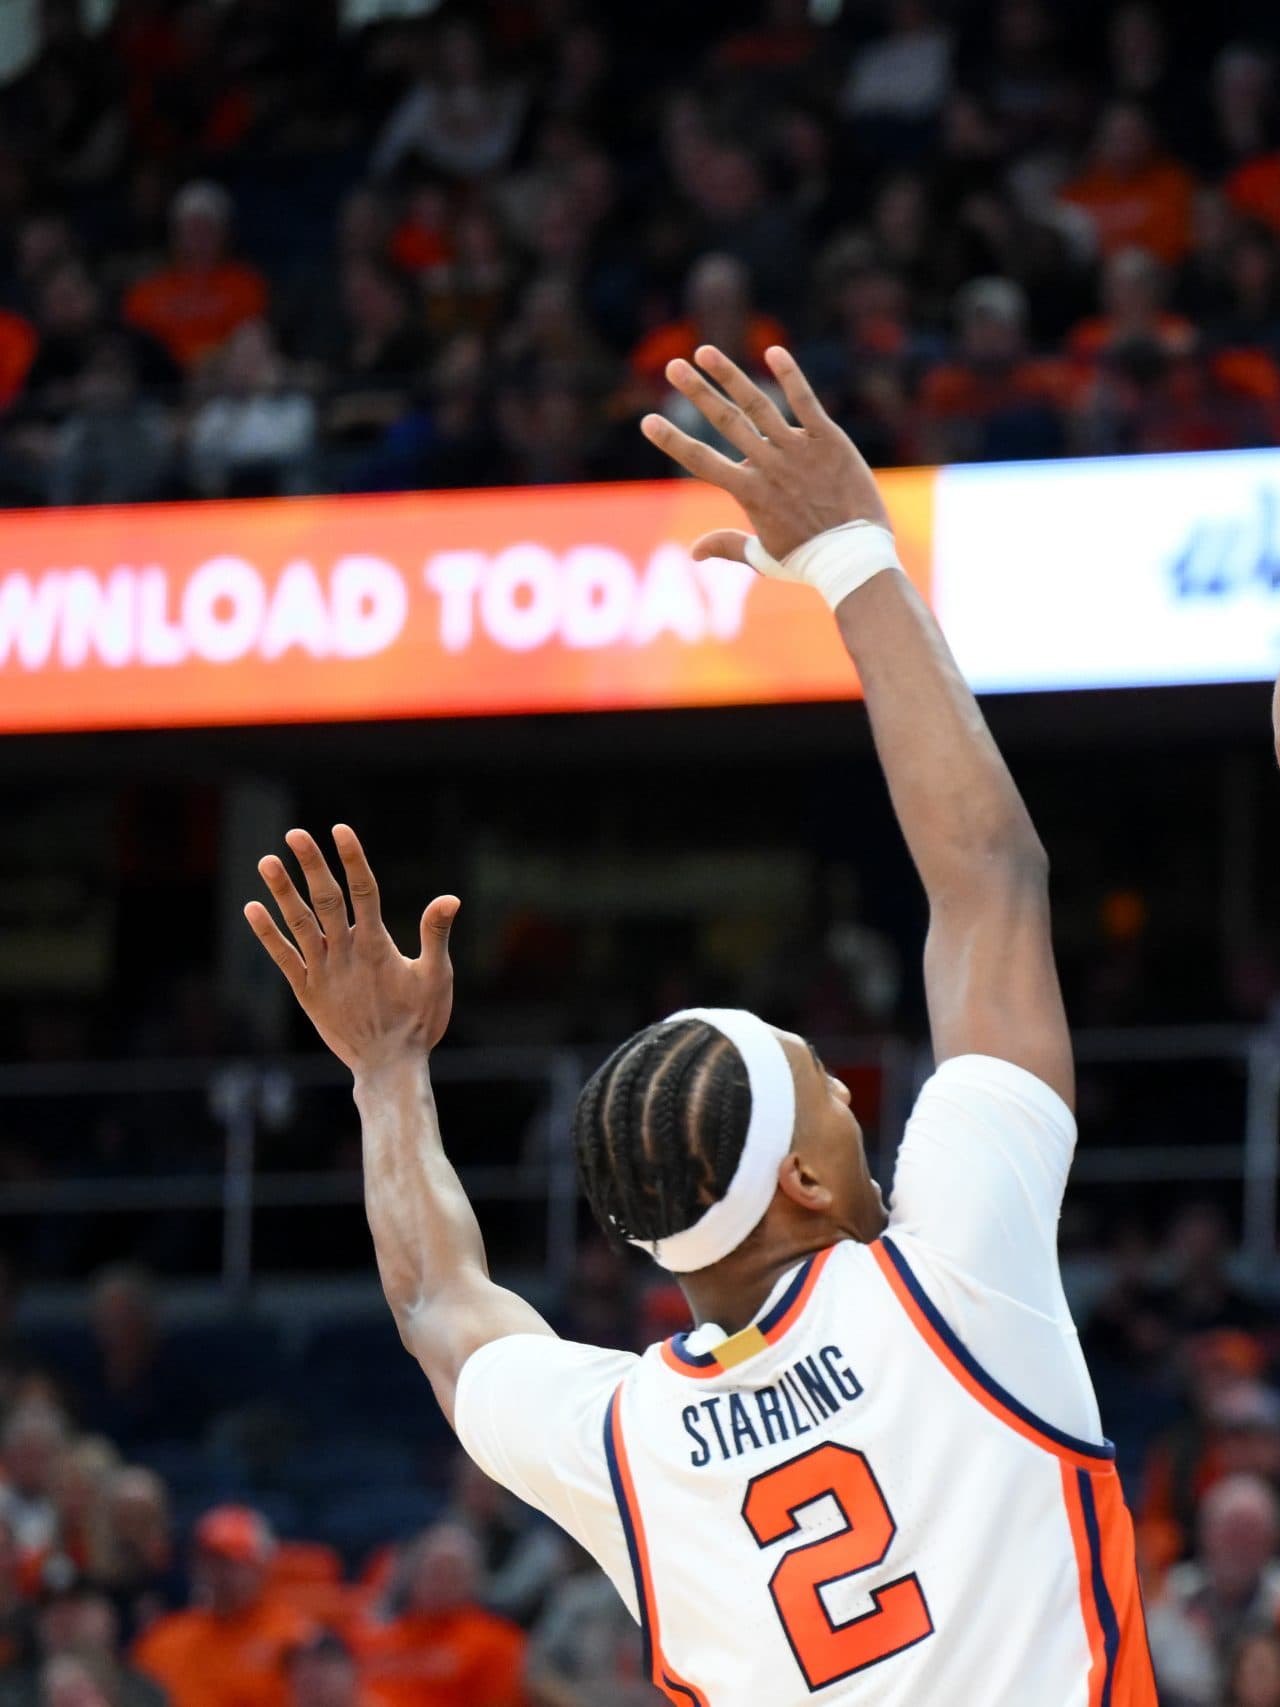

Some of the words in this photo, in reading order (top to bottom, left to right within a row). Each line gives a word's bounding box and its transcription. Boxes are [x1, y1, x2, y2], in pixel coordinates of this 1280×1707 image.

[426, 543, 757, 652] TODAY
[681, 1344, 864, 1467] STARLING
[740, 1440, 936, 1693] 2
